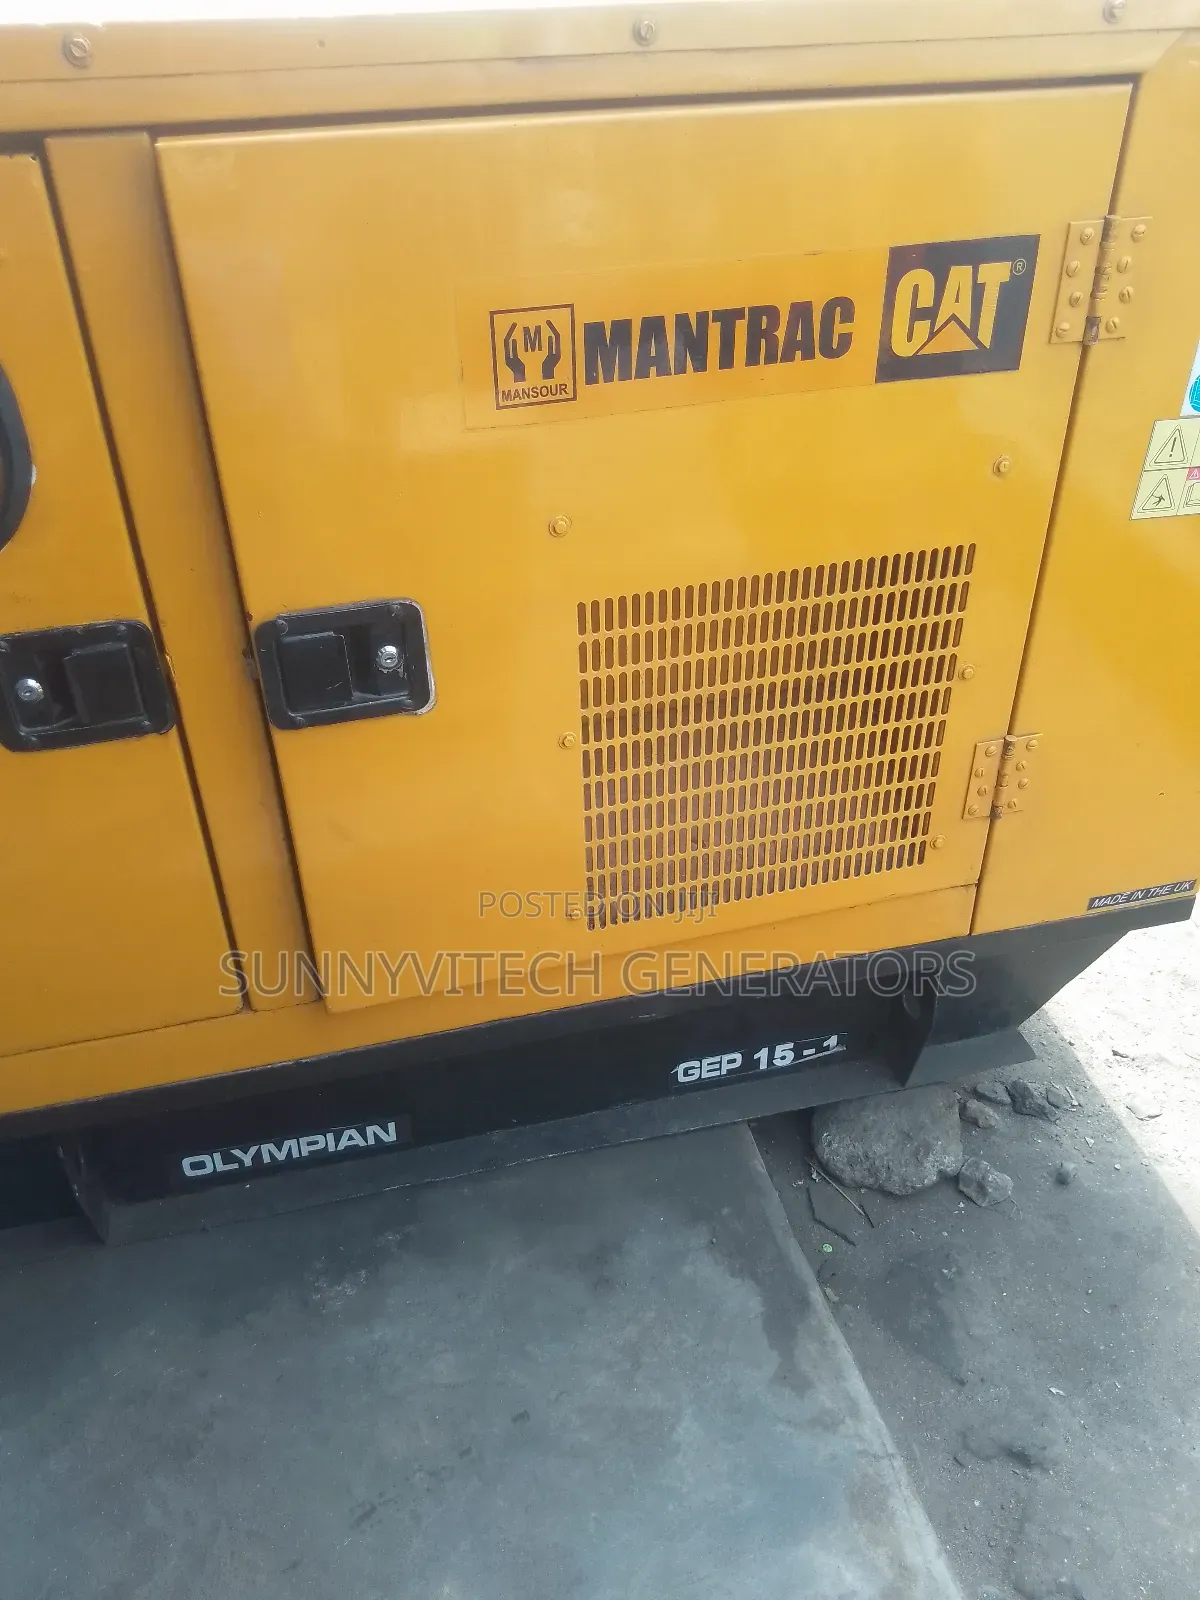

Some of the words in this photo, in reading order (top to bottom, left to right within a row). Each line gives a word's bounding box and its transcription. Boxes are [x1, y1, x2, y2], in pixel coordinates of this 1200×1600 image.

[891, 261, 1012, 358] CAT
[583, 296, 856, 386] MANTRAC
[500, 382, 570, 403] MANSOUR
[1091, 891, 1130, 908] MADE
[1130, 889, 1146, 901] IN
[1146, 884, 1174, 898] THE
[1173, 880, 1194, 892] UK
[676, 1051, 743, 1083] GEP
[753, 1042, 795, 1070] 15
[181, 1121, 397, 1177] OLYMPIAN
